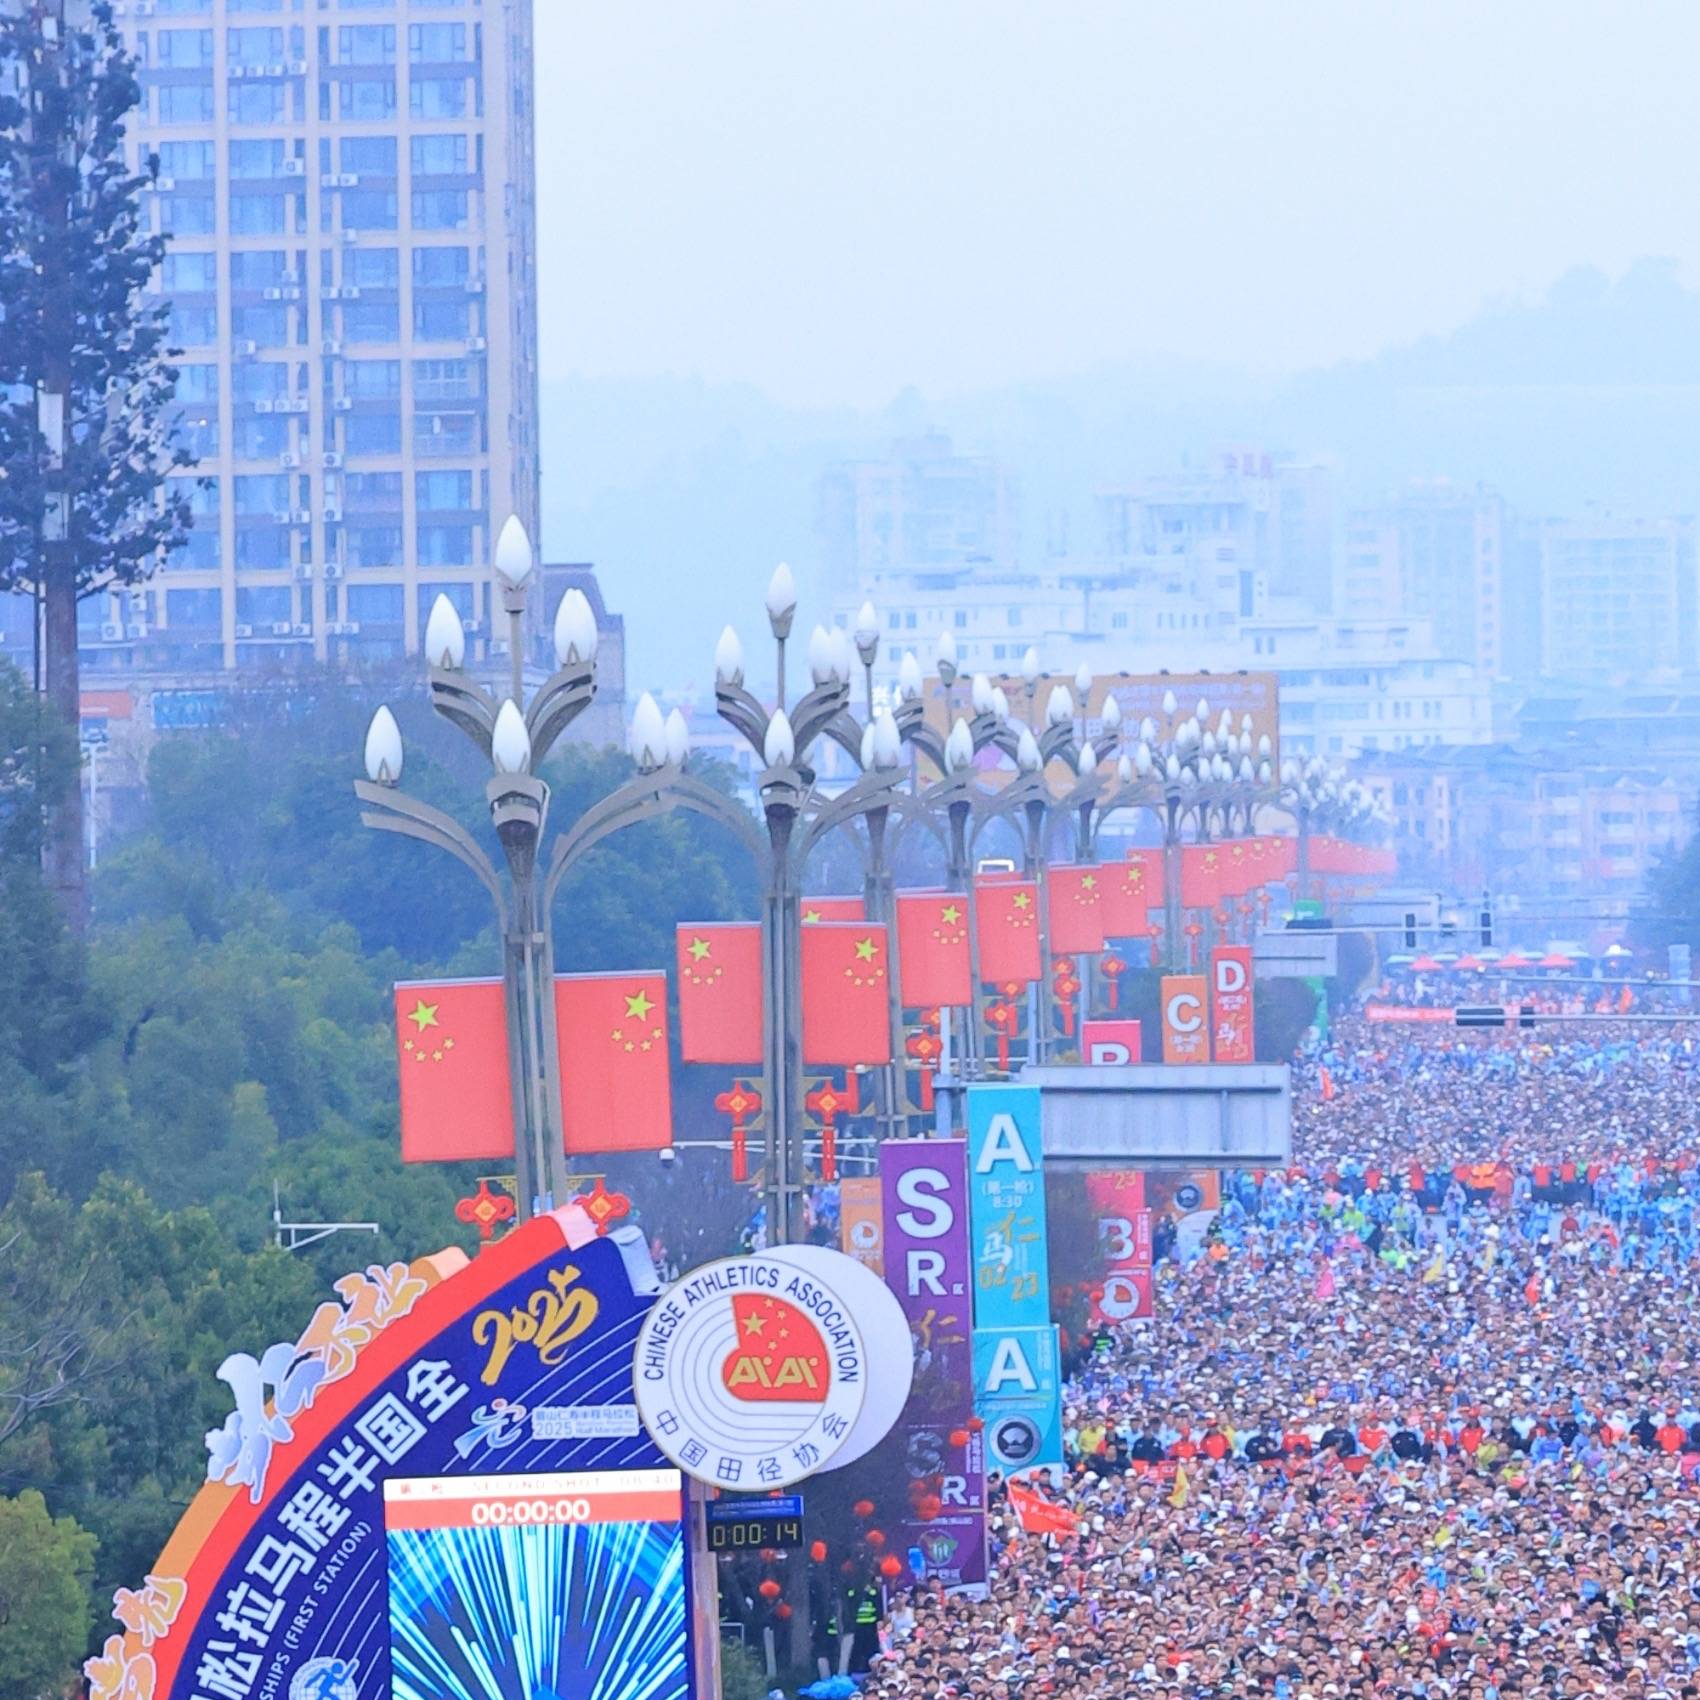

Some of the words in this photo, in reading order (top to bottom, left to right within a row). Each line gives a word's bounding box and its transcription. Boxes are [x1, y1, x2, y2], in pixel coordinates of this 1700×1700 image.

[1216, 959, 1246, 993] D
[1167, 993, 1202, 1032] C
[975, 1113, 1034, 1173] A
[895, 1167, 955, 1239] S
[643, 1301, 687, 1382] CHINESE
[682, 1266, 780, 1308] ATHLETICS
[784, 1276, 860, 1383] ASSOCIATION
[985, 1337, 1038, 1393] A
[656, 1409, 849, 1483] 中国田径协会
[470, 1498, 591, 1525] 00:00:00
